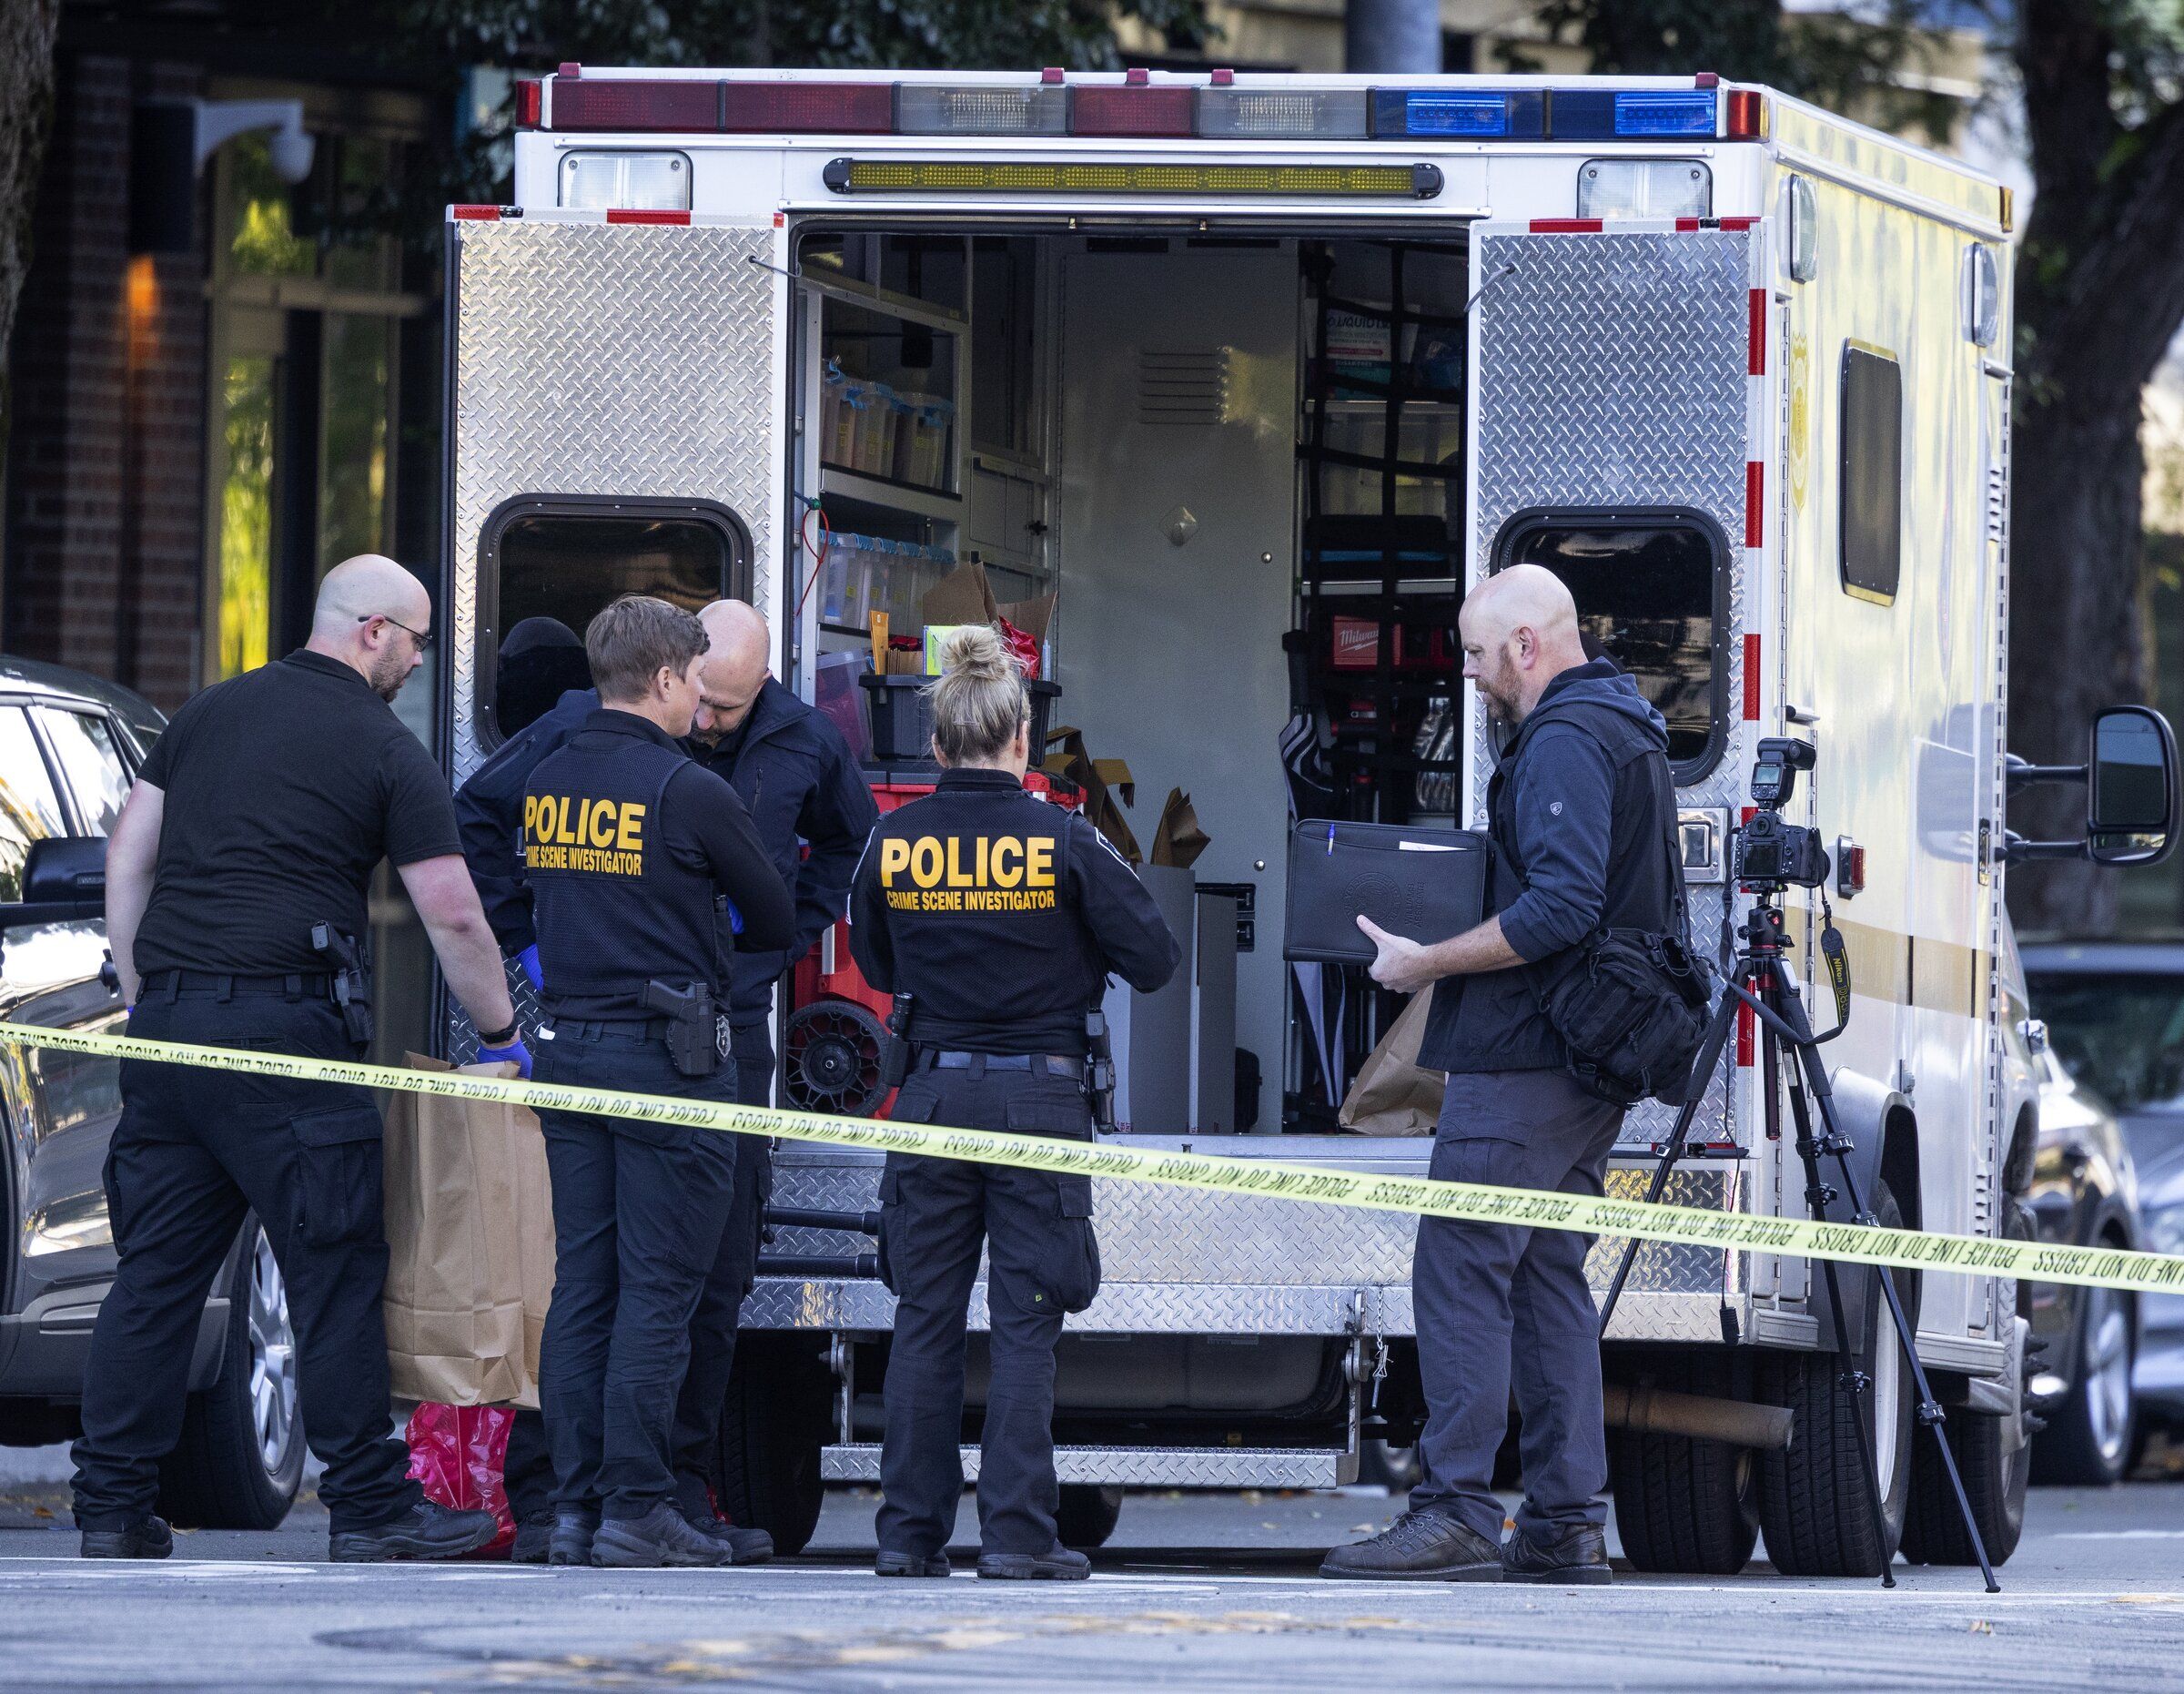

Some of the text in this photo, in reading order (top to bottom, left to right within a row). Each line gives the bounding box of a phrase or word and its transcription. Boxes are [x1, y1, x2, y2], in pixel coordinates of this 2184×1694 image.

[525, 795, 646, 850] POLICE
[541, 847, 568, 868] SCENE
[569, 847, 642, 876] INVESTIGATOR
[881, 836, 1055, 888] POLICE
[886, 890, 1055, 910] CRIME SCENE INVESTIGATOR
[1833, 958, 1844, 982] Nikon
[1148, 1158, 1360, 1198] POLICE LINE DO NOT CROSS
[1365, 1182, 1578, 1222] POLICE LINE DO NOT CROSS
[1585, 1204, 1800, 1246] POLICE LINE DO NOT CROSS
[1807, 1226, 2024, 1268] POLICE LINE DO NOT CROSS
[2033, 1251, 2097, 1275] CROSS
[2089, 1255, 2131, 1279] NOT
[2127, 1258, 2159, 1281] DO
